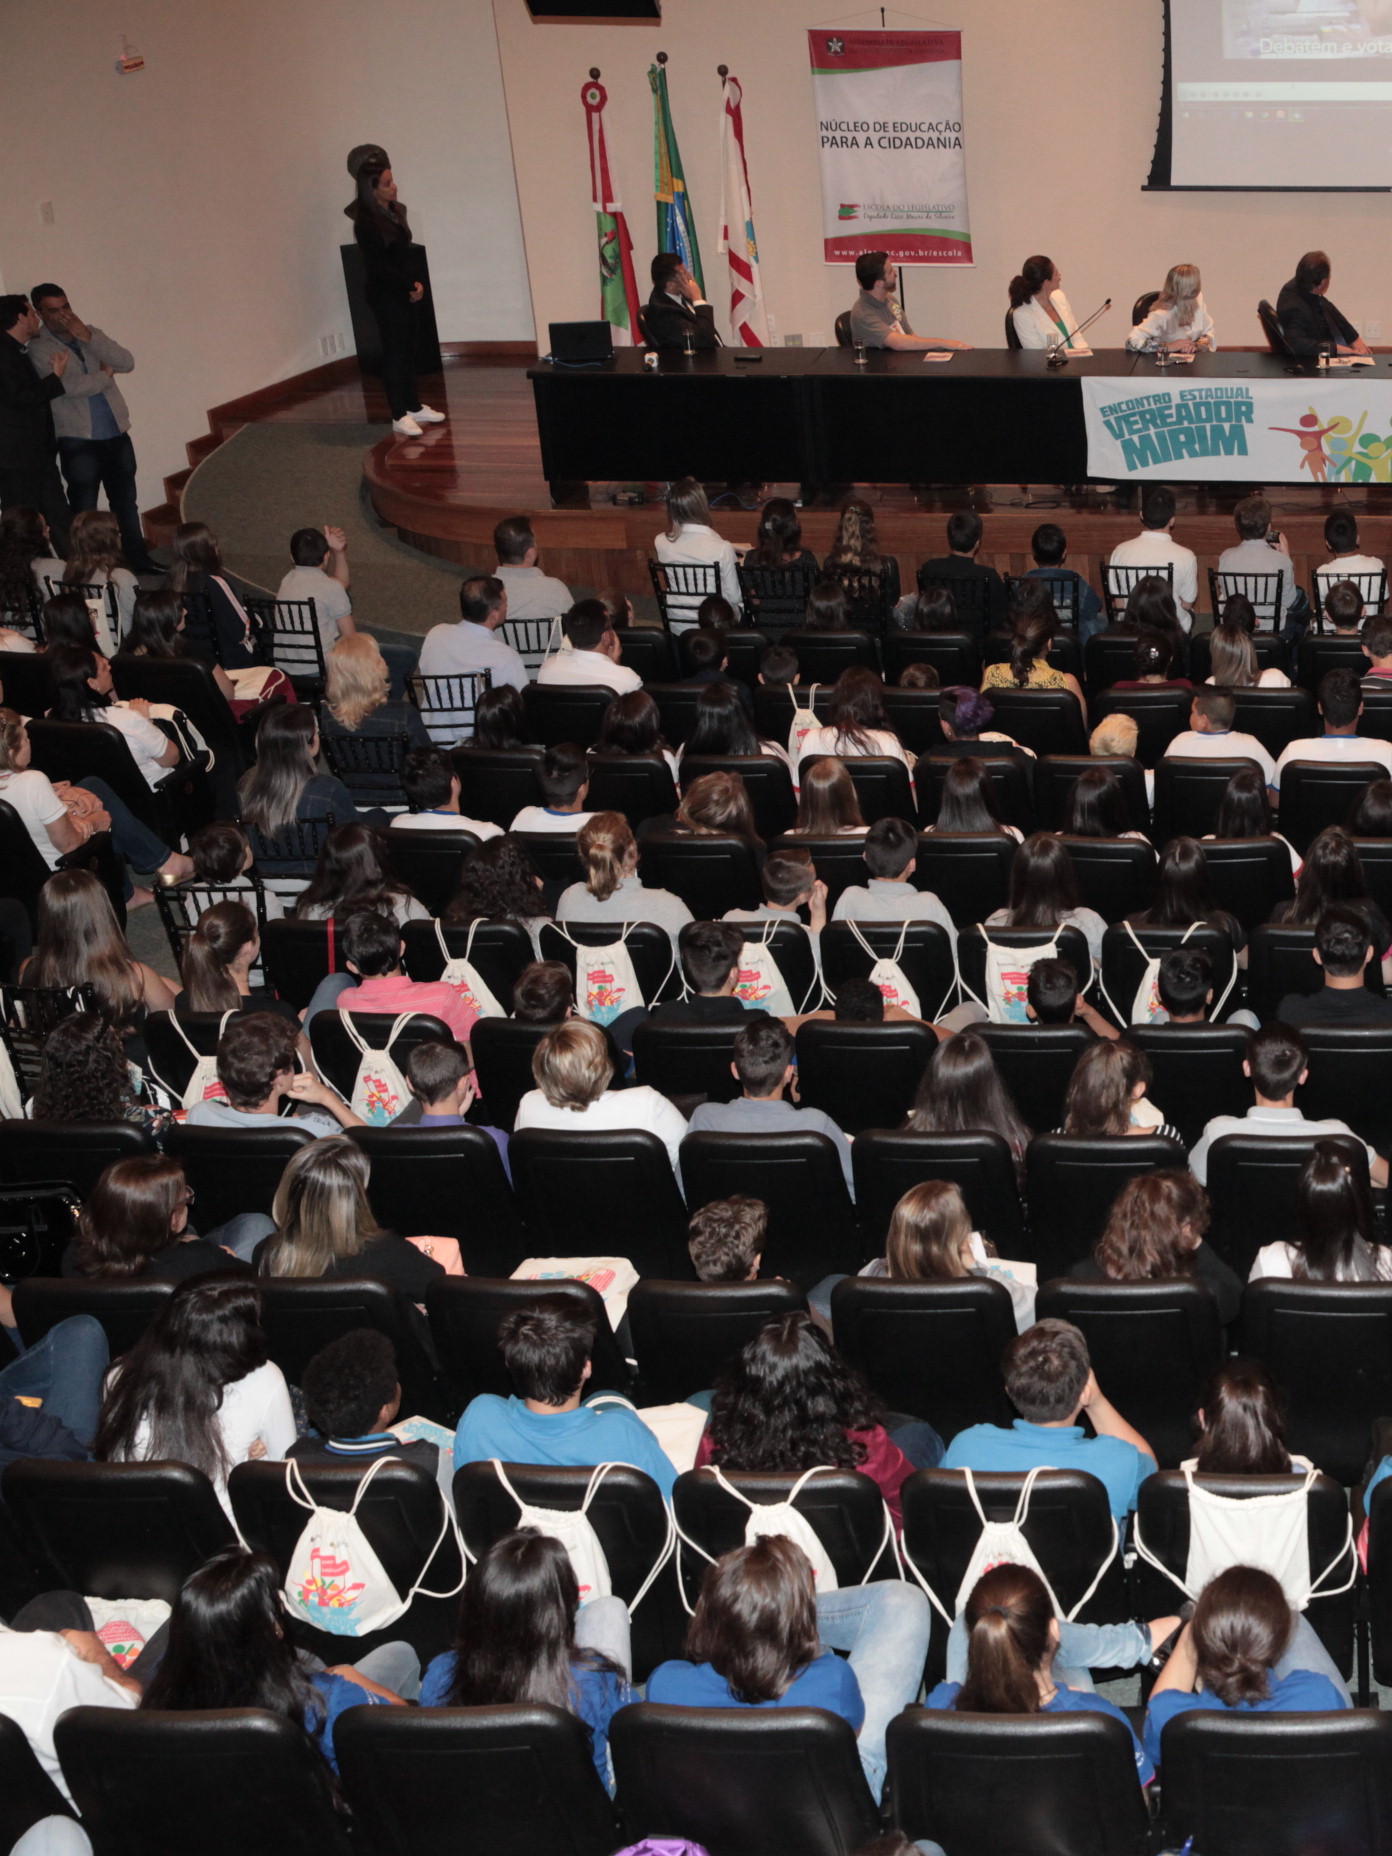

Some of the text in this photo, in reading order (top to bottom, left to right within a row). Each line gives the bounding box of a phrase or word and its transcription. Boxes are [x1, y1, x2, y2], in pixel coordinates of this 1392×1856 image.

[1260, 38, 1337, 53] Debatem
[1343, 43, 1352, 53] e
[820, 119, 962, 135] NÚCLEO DE EDUCAÇÃO
[821, 136, 963, 149] PARA A CIDADANIA
[1100, 387, 1253, 418] ENCONTRO ESTADUAL
[1102, 400, 1254, 441] VEREADOR
[1120, 423, 1249, 472] MIRIM
